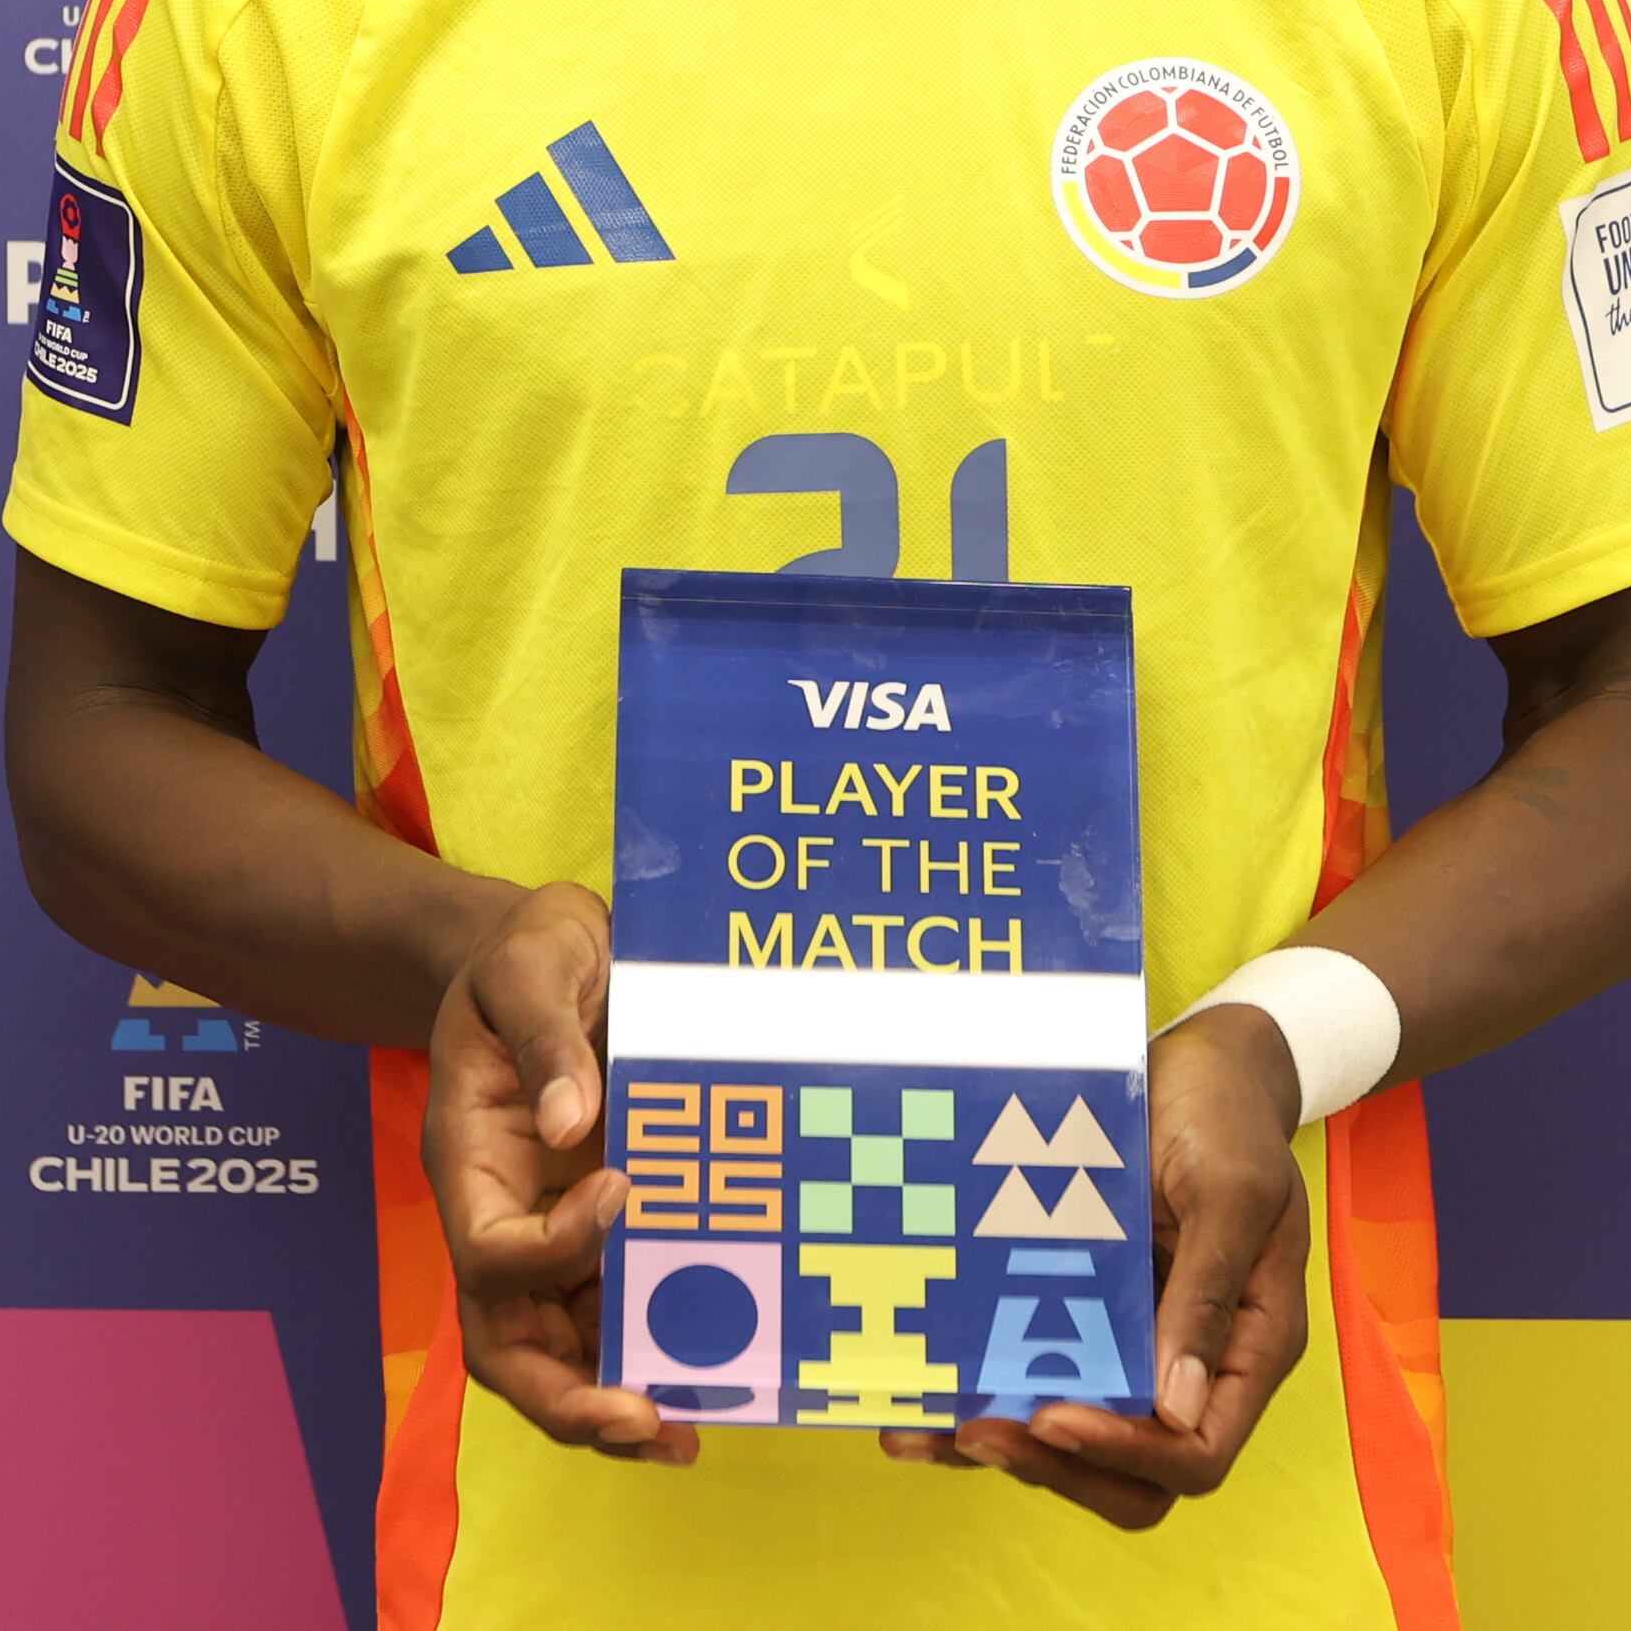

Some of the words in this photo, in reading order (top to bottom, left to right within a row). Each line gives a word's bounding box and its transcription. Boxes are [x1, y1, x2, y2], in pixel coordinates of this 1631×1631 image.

[1118, 66, 1230, 96] COLOMBIANA
[1232, 89, 1255, 111] DE
[46, 319, 72, 343] FIFA
[70, 349, 89, 361] CUP
[787, 679, 952, 731] VISA
[729, 759, 1023, 820] PLAYER
[727, 834, 835, 892] OF
[862, 838, 1022, 897] THE
[727, 911, 1024, 976] MATCH
[123, 1076, 224, 1112] FIFA
[67, 1124, 126, 1145] U-20
[129, 1125, 223, 1146] WORLD
[228, 1126, 280, 1146] CUP
